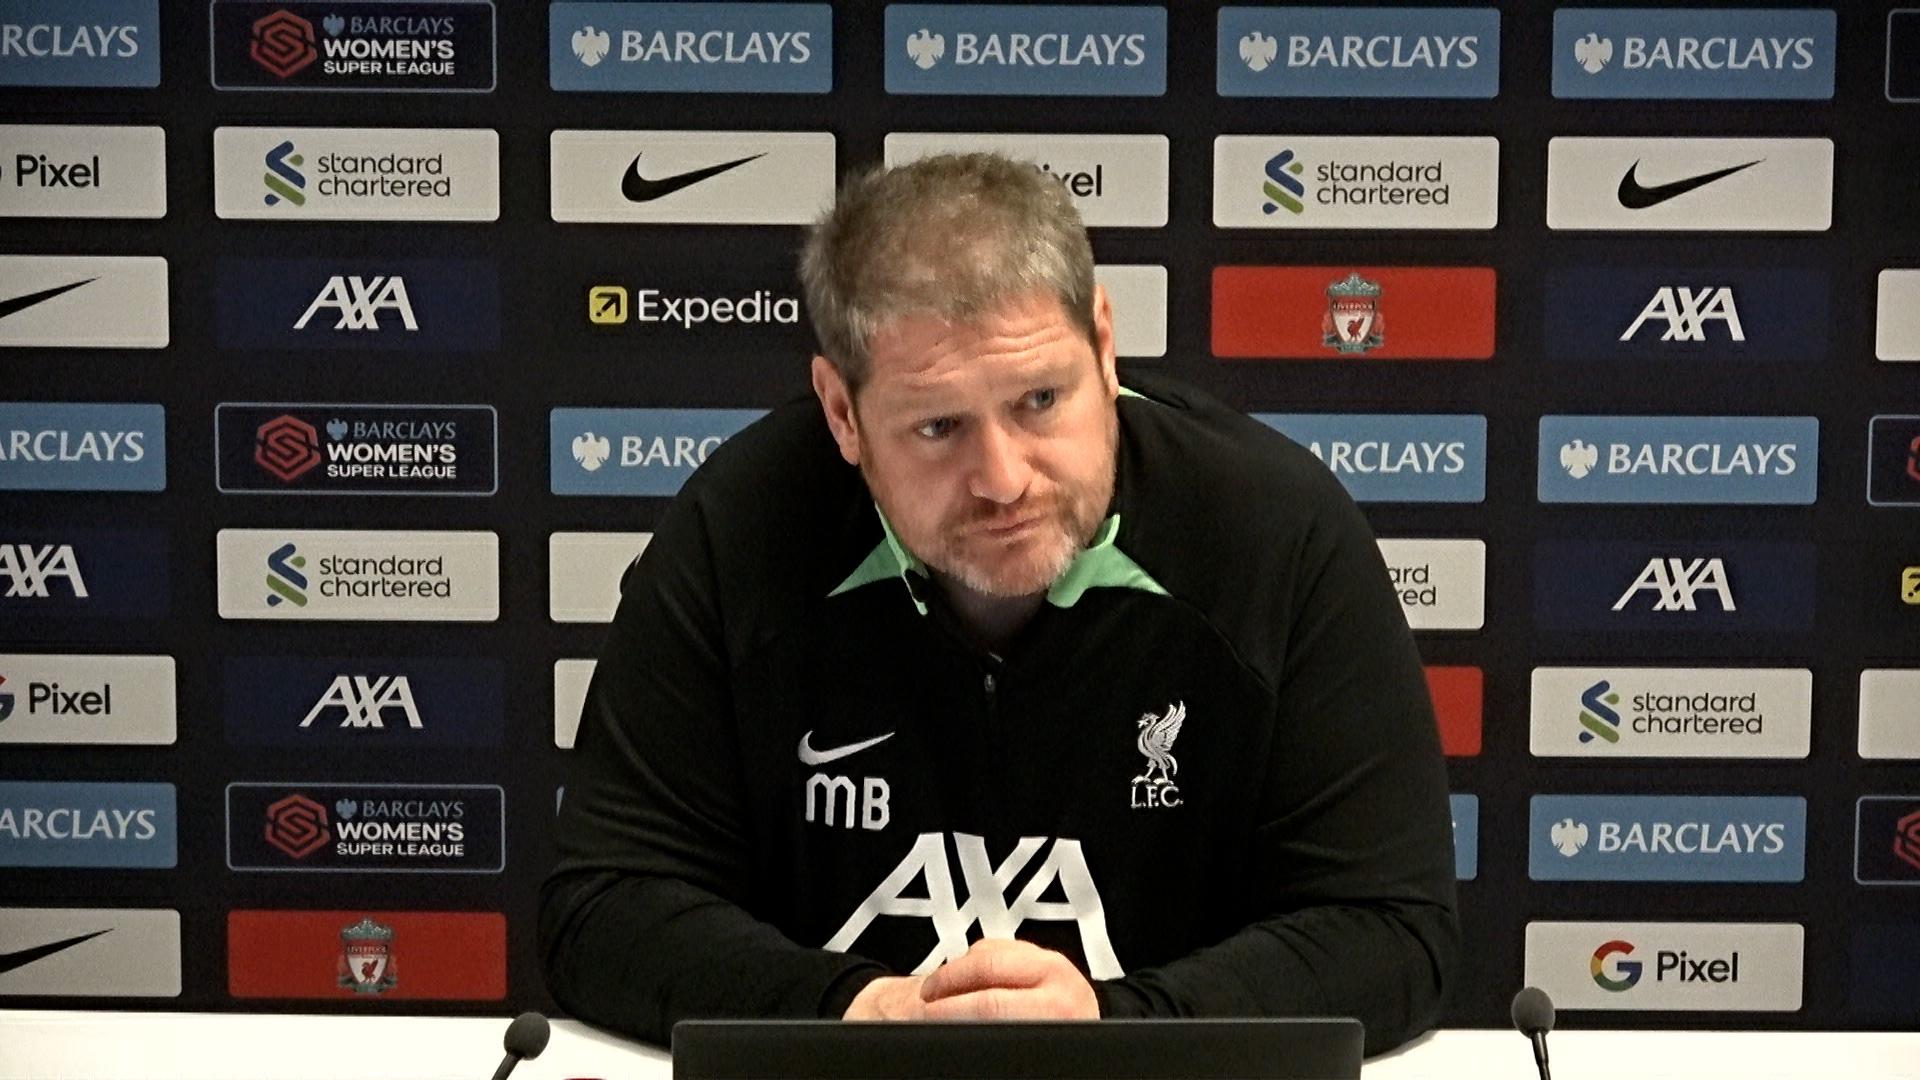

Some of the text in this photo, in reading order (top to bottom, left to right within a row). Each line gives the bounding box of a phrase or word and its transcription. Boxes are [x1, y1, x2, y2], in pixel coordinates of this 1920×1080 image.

[351, 17, 454, 34] BARCLAYS
[3, 25, 138, 57] RCLAYS
[324, 39, 454, 58] WOMEN'S
[621, 31, 810, 63] BARCLAYS
[956, 34, 1144, 65] BARCLAYS
[1288, 36, 1477, 68] BARCLAYS
[1624, 38, 1813, 69] BARCLAYS
[325, 61, 454, 74] SUPER LEAGUE
[17, 155, 99, 187] Pixel
[319, 153, 441, 174] standard
[1318, 161, 1441, 182] standard
[319, 175, 450, 196] chartered
[1051, 164, 1103, 197] xel
[1317, 182, 1448, 204] chartered
[293, 276, 418, 330] AXA
[639, 290, 798, 328] Expedia
[1620, 287, 1745, 341] AXA
[354, 422, 455, 439] BARCLAYS
[0, 431, 143, 461] RCLAYS
[328, 444, 456, 462] WOMEN'S
[621, 437, 721, 468] BARC
[1310, 442, 1464, 473] RCLAYS
[1608, 444, 1796, 474] BARCLAYS
[328, 465, 456, 478] SUPER LEAGUE
[0, 545, 88, 597] AXA
[320, 555, 442, 575] standard
[320, 577, 450, 597] chartered
[1612, 558, 1736, 611] AXA
[29, 683, 110, 714] Pixel
[299, 676, 423, 728] AXA
[1633, 693, 1755, 712] standard
[1633, 714, 1762, 734] chartered
[364, 801, 463, 817] BARCLAYS
[806, 773, 889, 830] MB
[0, 809, 155, 839] ARCLAYS
[337, 823, 463, 840] WOMEN'S
[1599, 823, 1784, 853] BARCLAYS
[337, 843, 463, 855] SUPER LEAGUE
[822, 831, 1126, 982] AXA
[1657, 951, 1738, 982] Pixel
